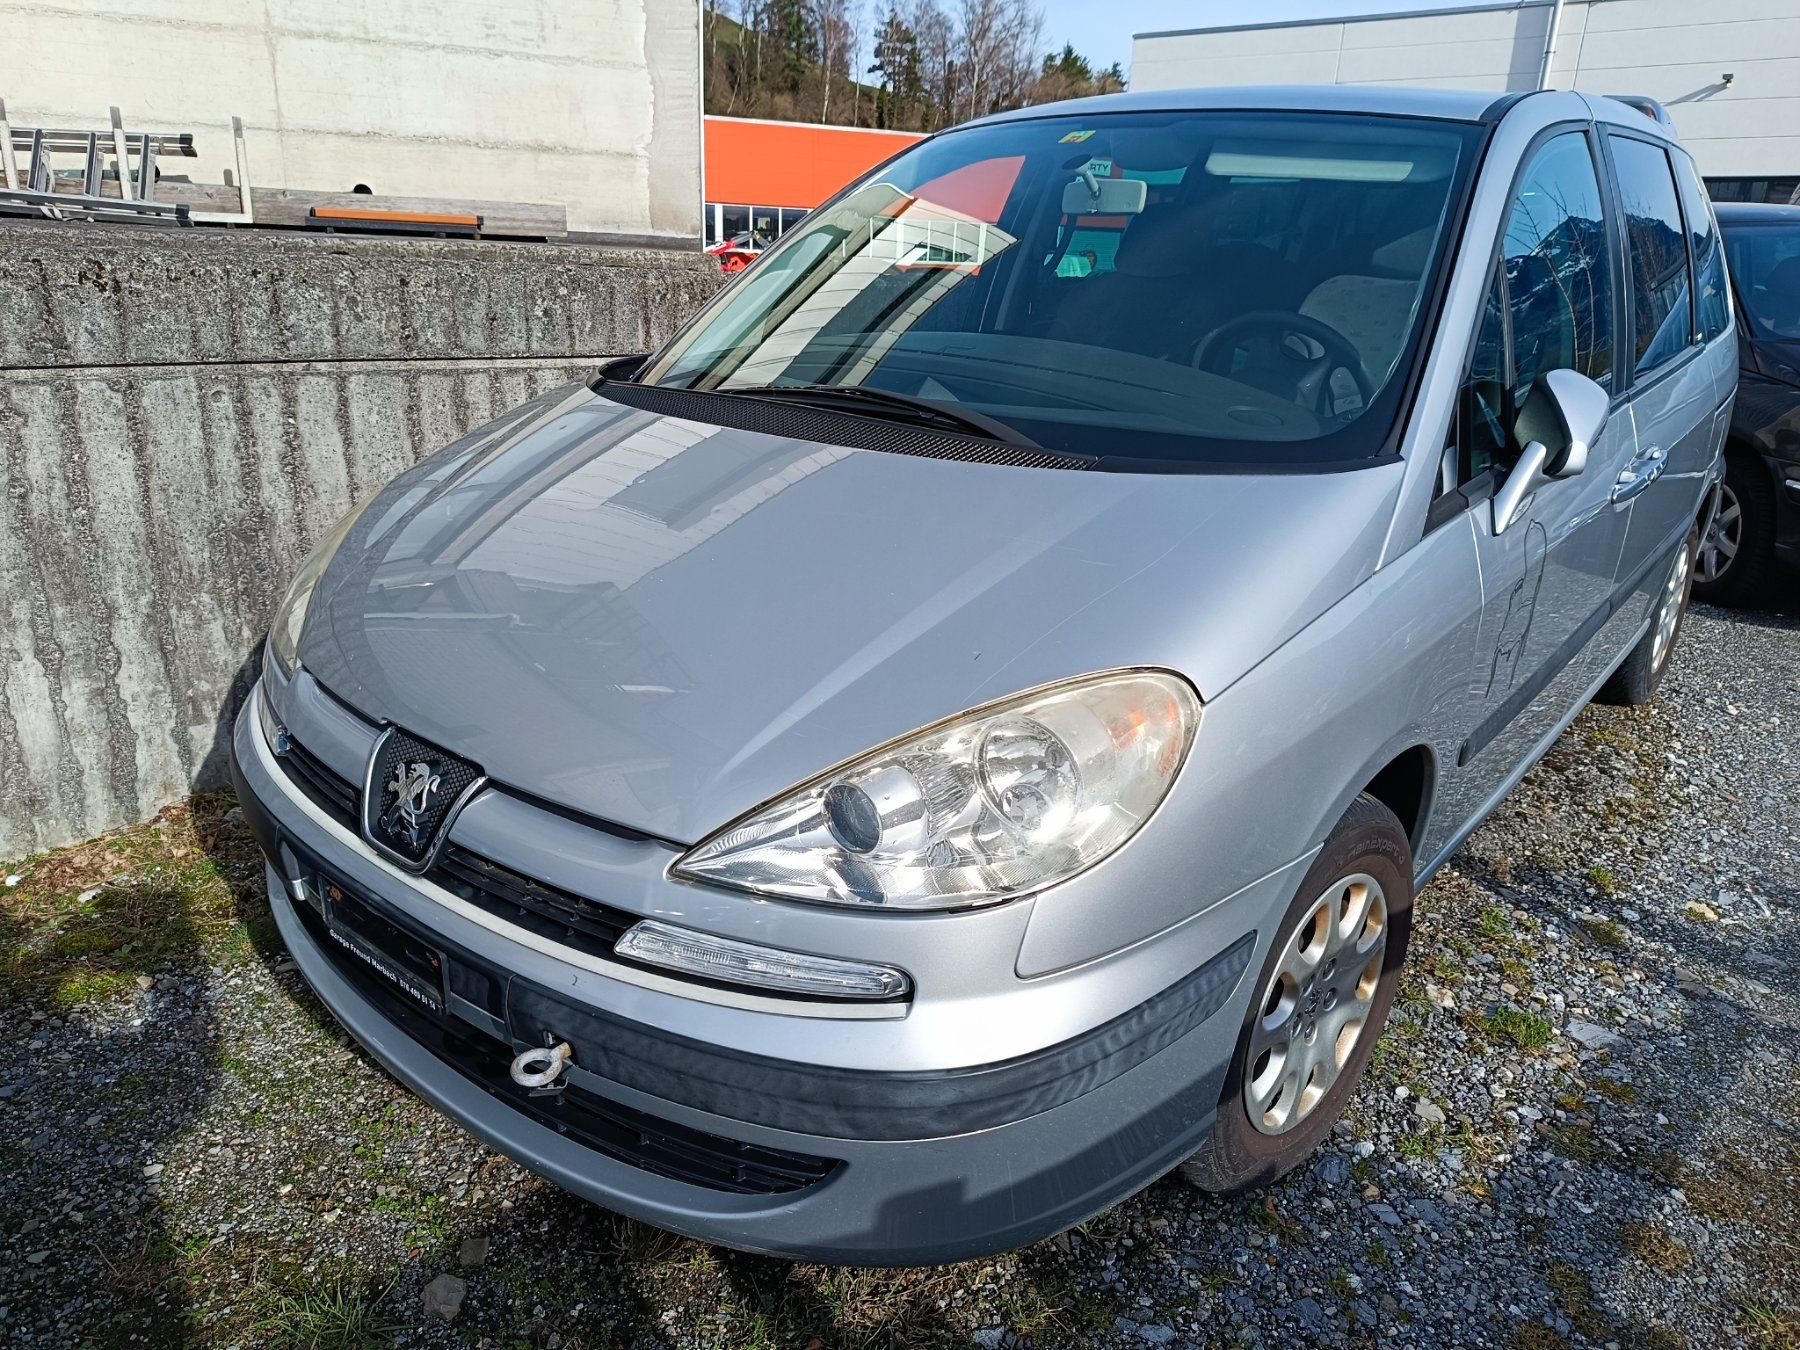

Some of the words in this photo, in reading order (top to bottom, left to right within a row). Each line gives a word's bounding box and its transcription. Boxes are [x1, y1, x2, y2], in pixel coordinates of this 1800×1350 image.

[1088, 162, 1109, 172] RTY
[330, 929, 349, 948] Garage
[350, 943, 370, 963] Freund
[371, 958, 397, 982] Marbach
